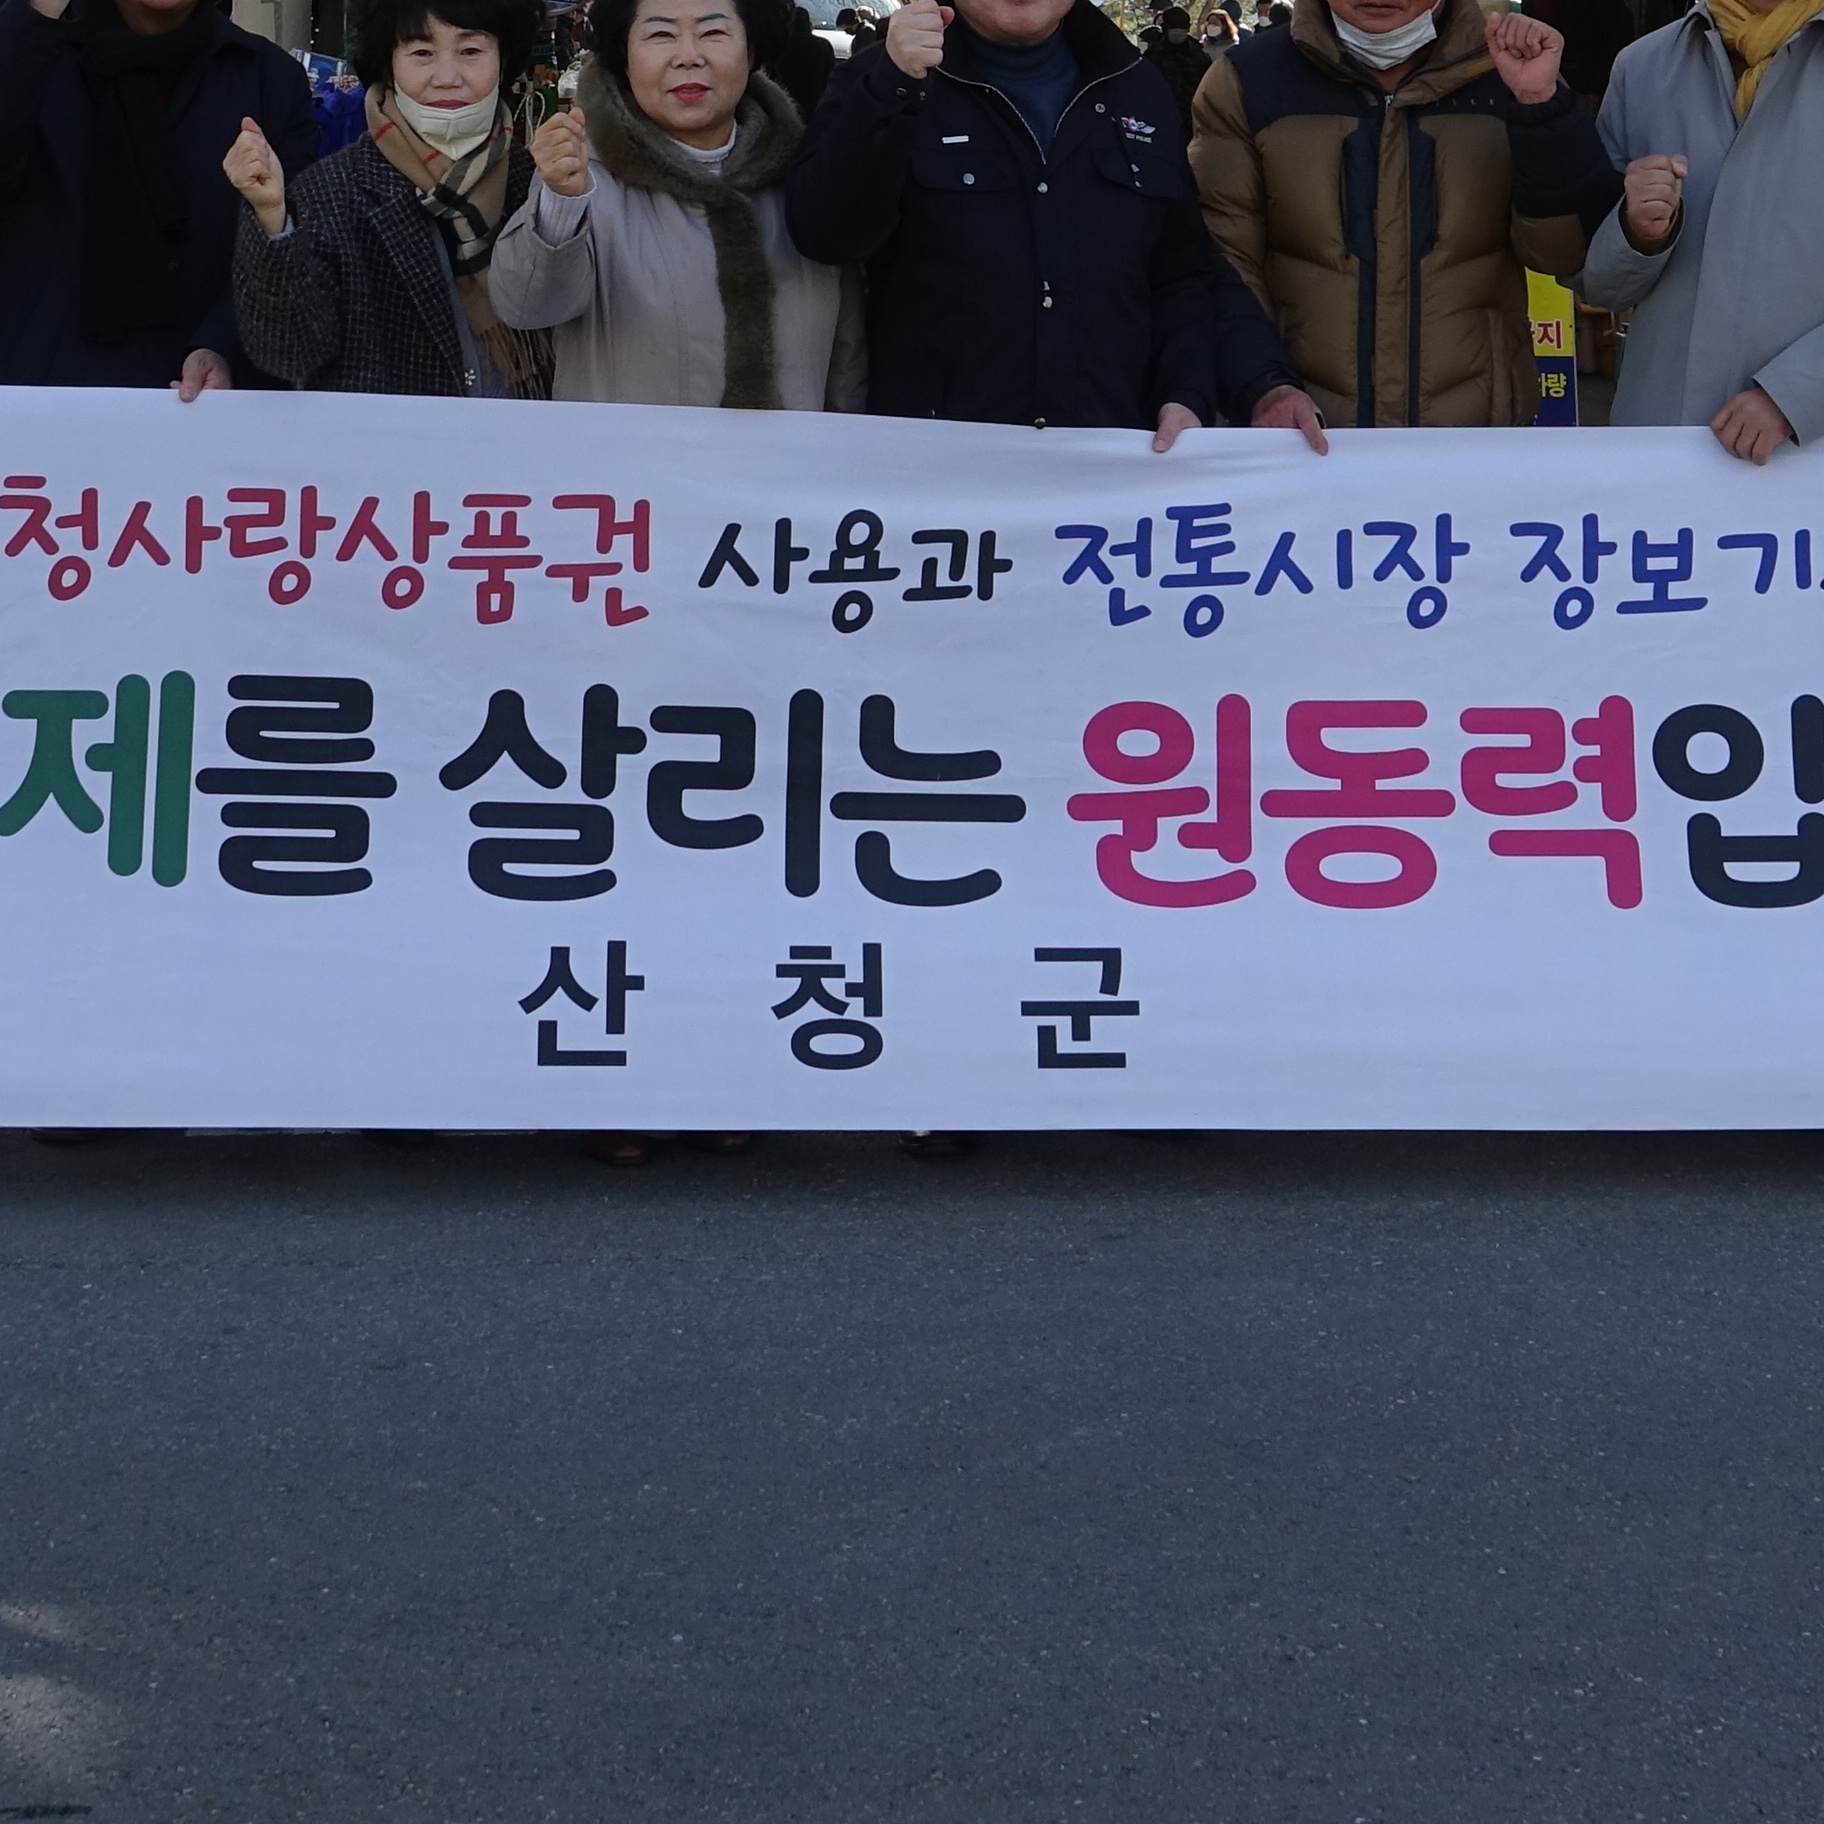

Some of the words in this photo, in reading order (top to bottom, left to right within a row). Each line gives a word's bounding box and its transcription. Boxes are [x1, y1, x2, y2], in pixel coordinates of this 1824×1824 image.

[696, 510, 1014, 636] 사용과
[1054, 501, 1472, 640] 전통시장
[438, 681, 1025, 901] 살리는
